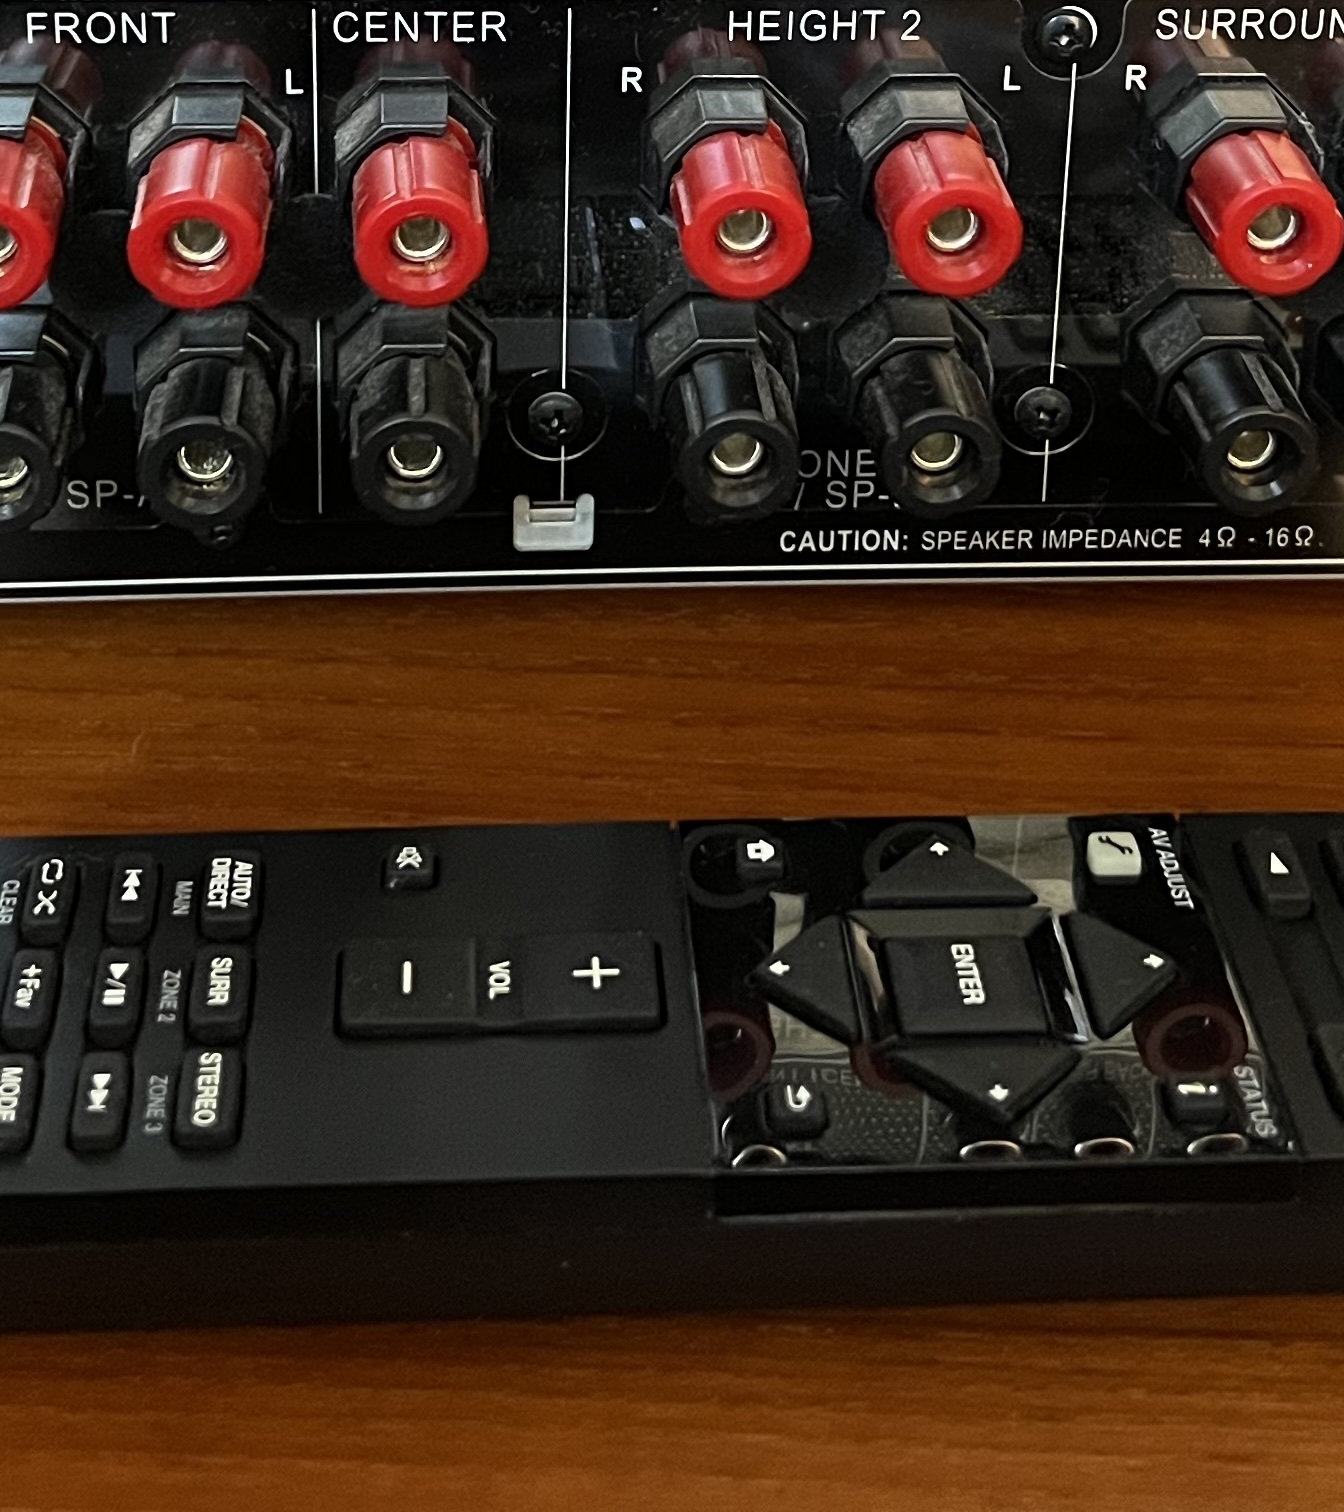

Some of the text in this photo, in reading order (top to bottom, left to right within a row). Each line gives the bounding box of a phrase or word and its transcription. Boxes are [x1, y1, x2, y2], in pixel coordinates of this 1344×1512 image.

[27, 12, 175, 44] FRONT
[333, 11, 506, 43] CENTER
[729, 10, 920, 41] HEIGHT 2
[780, 528, 1182, 552] CAUTION: SPEAKER IMPEDANCE
[1147, 827, 1194, 909] AV ADJUST
[207, 958, 232, 1005] SURR
[489, 961, 510, 999] VOL
[951, 944, 985, 1004] ENTER
[192, 1053, 222, 1126] STEREO
[1227, 1066, 1277, 1139] STATUS
